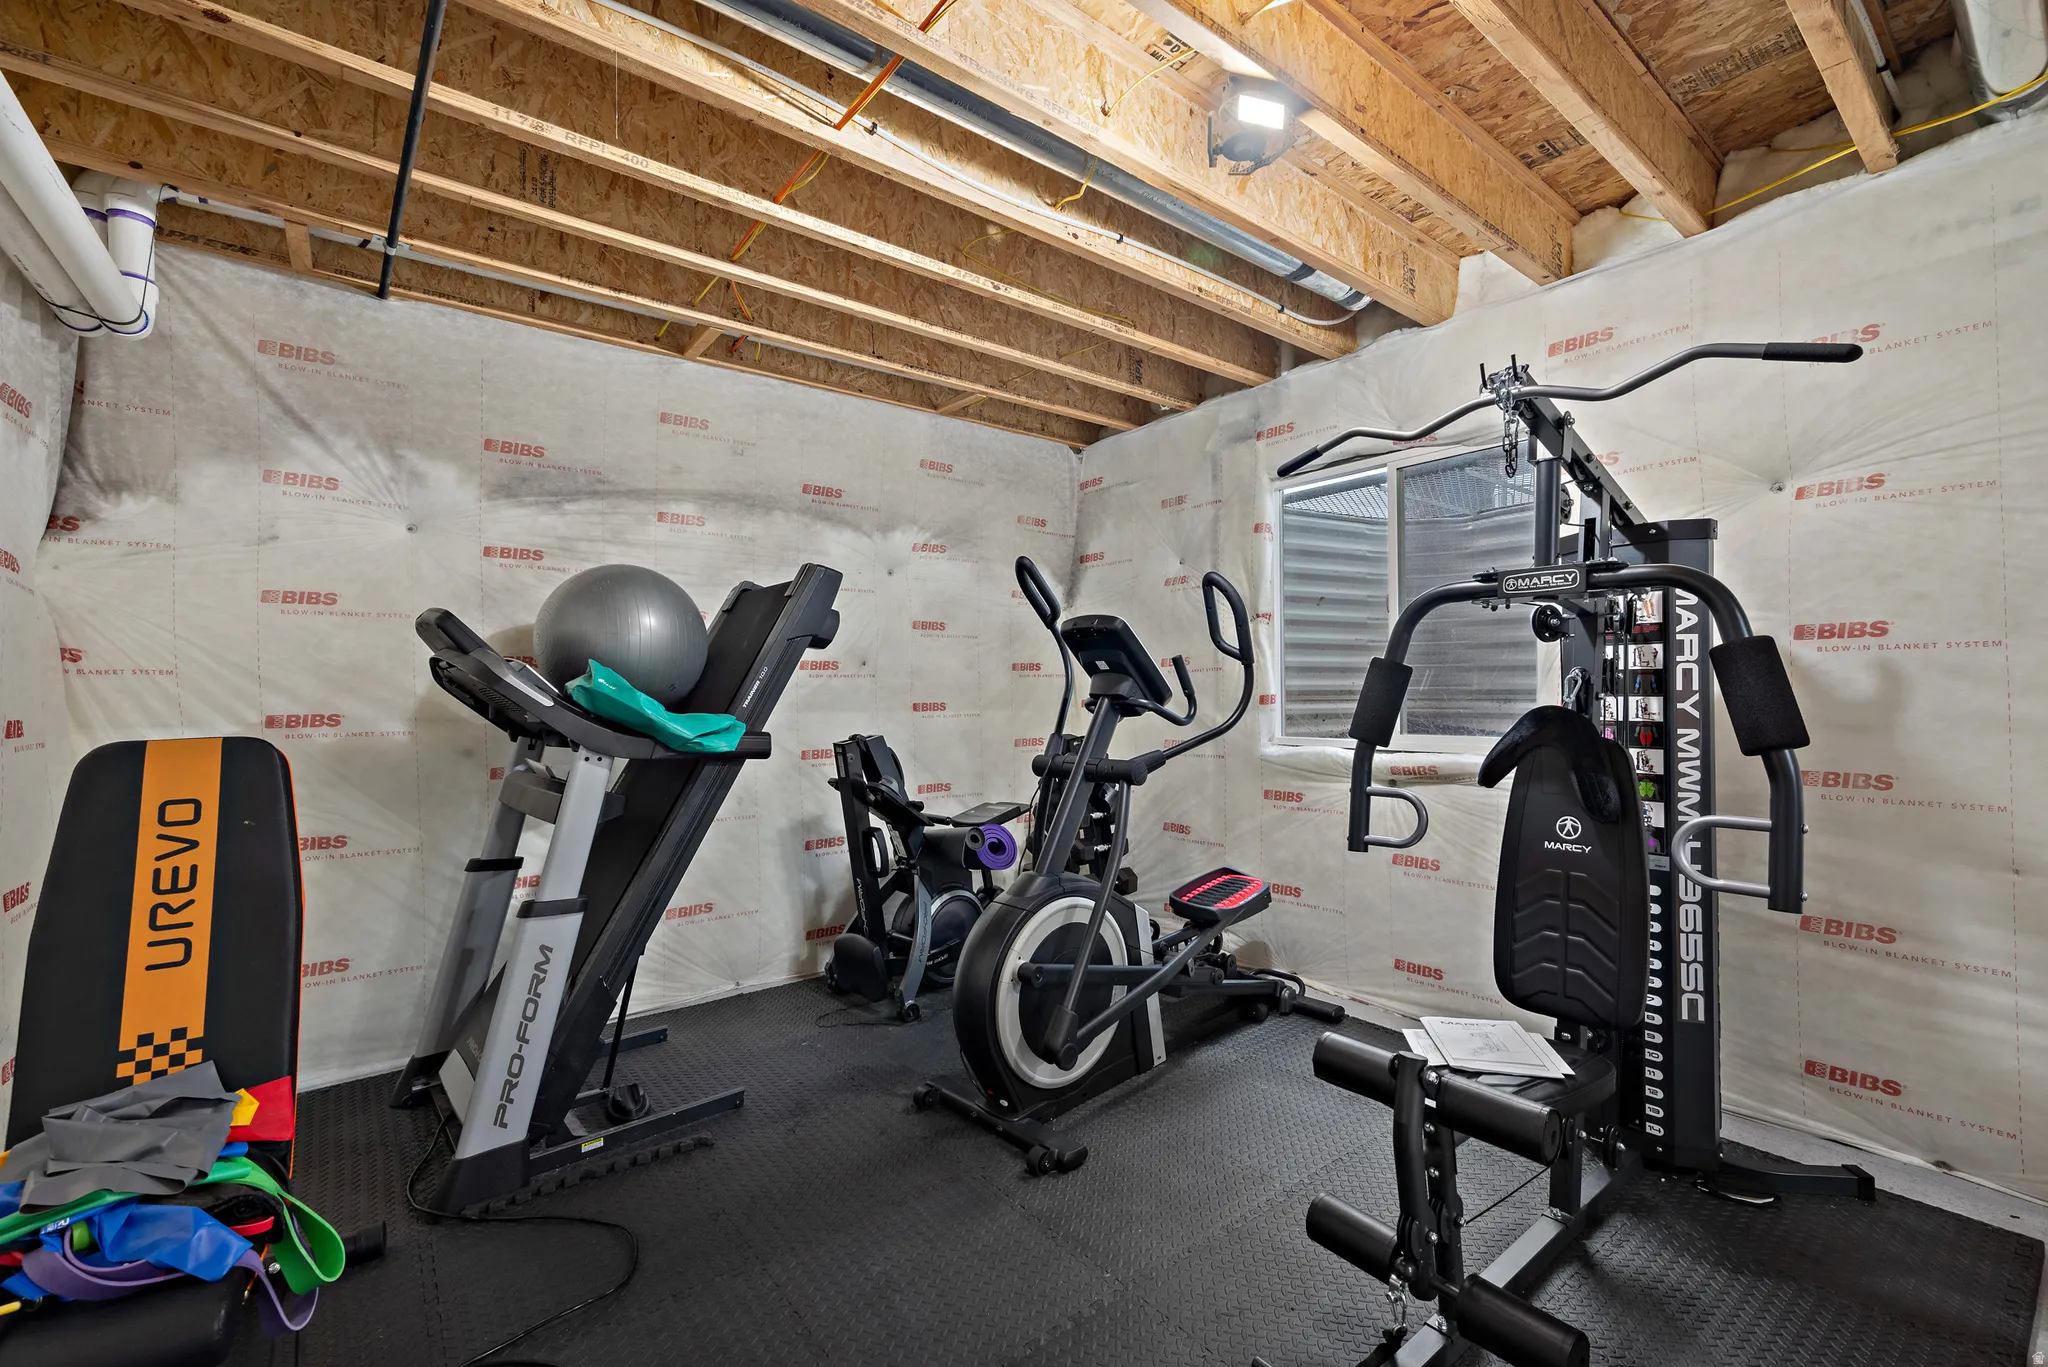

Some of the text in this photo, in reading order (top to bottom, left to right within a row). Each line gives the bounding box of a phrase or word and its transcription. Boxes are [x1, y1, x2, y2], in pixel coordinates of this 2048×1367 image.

[565, 132, 606, 153] RFPI
[623, 152, 649, 169] 400
[1552, 242, 1562, 275] APA
[1407, 267, 1416, 299] APA
[1564, 327, 1615, 353] BIBS
[1564, 324, 1690, 364] BLOW-IN BLANKET SYSTEM
[1869, 320, 1993, 355] BLANKET SYSTEM
[279, 343, 336, 365] BIBS
[278, 363, 370, 384] BLOW-IN BLANKET
[1134, 359, 1142, 385] APA
[126, 405, 171, 416] SYSTEM
[674, 415, 710, 431] BIBS
[1265, 422, 1295, 439] BIBS
[500, 441, 545, 458] BIBS
[499, 458, 603, 477] BLOW-IN BLANKET SYSTEM
[928, 461, 953, 474] BIBS
[1659, 457, 1698, 468] SYSTEM
[283, 472, 339, 491] BIBS
[1084, 476, 1103, 489] BIBS
[1816, 473, 1886, 497] BIBS
[282, 490, 326, 501] BLOW-IN
[813, 485, 843, 499] BIBS
[1815, 479, 1997, 509] BLOW-IN BLANKET SYSTEM
[670, 513, 706, 527] BIBS
[1024, 516, 1047, 527] BIBS
[68, 537, 121, 547] BLANKET
[127, 541, 171, 549] SYSTEM
[920, 543, 947, 554] BIBS
[500, 548, 544, 562] BIBS
[1085, 552, 1104, 563] BIBS
[1518, 573, 1576, 586] MARCY
[281, 591, 338, 606] BIBS
[329, 610, 371, 618] BLANKET
[921, 621, 946, 631] BIBS
[1817, 621, 1889, 641] BIBS
[1675, 588, 1700, 719] MARCY
[1817, 641, 2002, 653] BLOW-IN BLANKET SYSTEM
[131, 668, 174, 676] SYSTEM
[811, 660, 839, 671] BIBS
[1019, 662, 1042, 671] BIBS
[743, 680, 760, 708] TRAINER
[921, 702, 947, 712] BIBS
[285, 714, 341, 729] BIBS
[285, 732, 328, 740] BLOW-IN
[1022, 738, 1044, 747] BIBS
[1402, 766, 1438, 776] BIBS
[1822, 771, 1894, 791] BIBS
[926, 783, 952, 795] BIBS
[1274, 791, 1303, 803] BIBS
[1821, 794, 2008, 813] BLOW-IN BLANKET SYSTEM
[1170, 823, 1191, 835] BIBS
[300, 835, 348, 851] BIBS
[815, 836, 845, 850] BIBS
[1544, 841, 1592, 853] MARCY
[339, 846, 420, 860] BLANKET SYSTEM
[1404, 856, 1441, 871] BIBS
[145, 798, 202, 971] UREVO
[514, 875, 541, 890] BIB
[1404, 871, 1495, 891] BLOW-IN BLANKET SYSTEM
[1271, 883, 1302, 898] BIBS
[677, 902, 714, 920] BIBS
[816, 924, 846, 939] BIBS
[1824, 918, 1897, 945] BIBS
[1823, 940, 2012, 978] BLOW-IN BLANKET SYSTEM
[302, 958, 350, 979] BIBS
[341, 965, 423, 983] BLANKET SYSTEM
[1406, 964, 1444, 981] BIBS
[1407, 977, 1500, 1005] BLOW-IN BLANKET SYSTEM
[493, 944, 553, 1130] PRO-FORM
[1829, 1067, 1902, 1097] BIBS
[1829, 1086, 2017, 1140] BLOW-IN BLANKET SYSTEM
